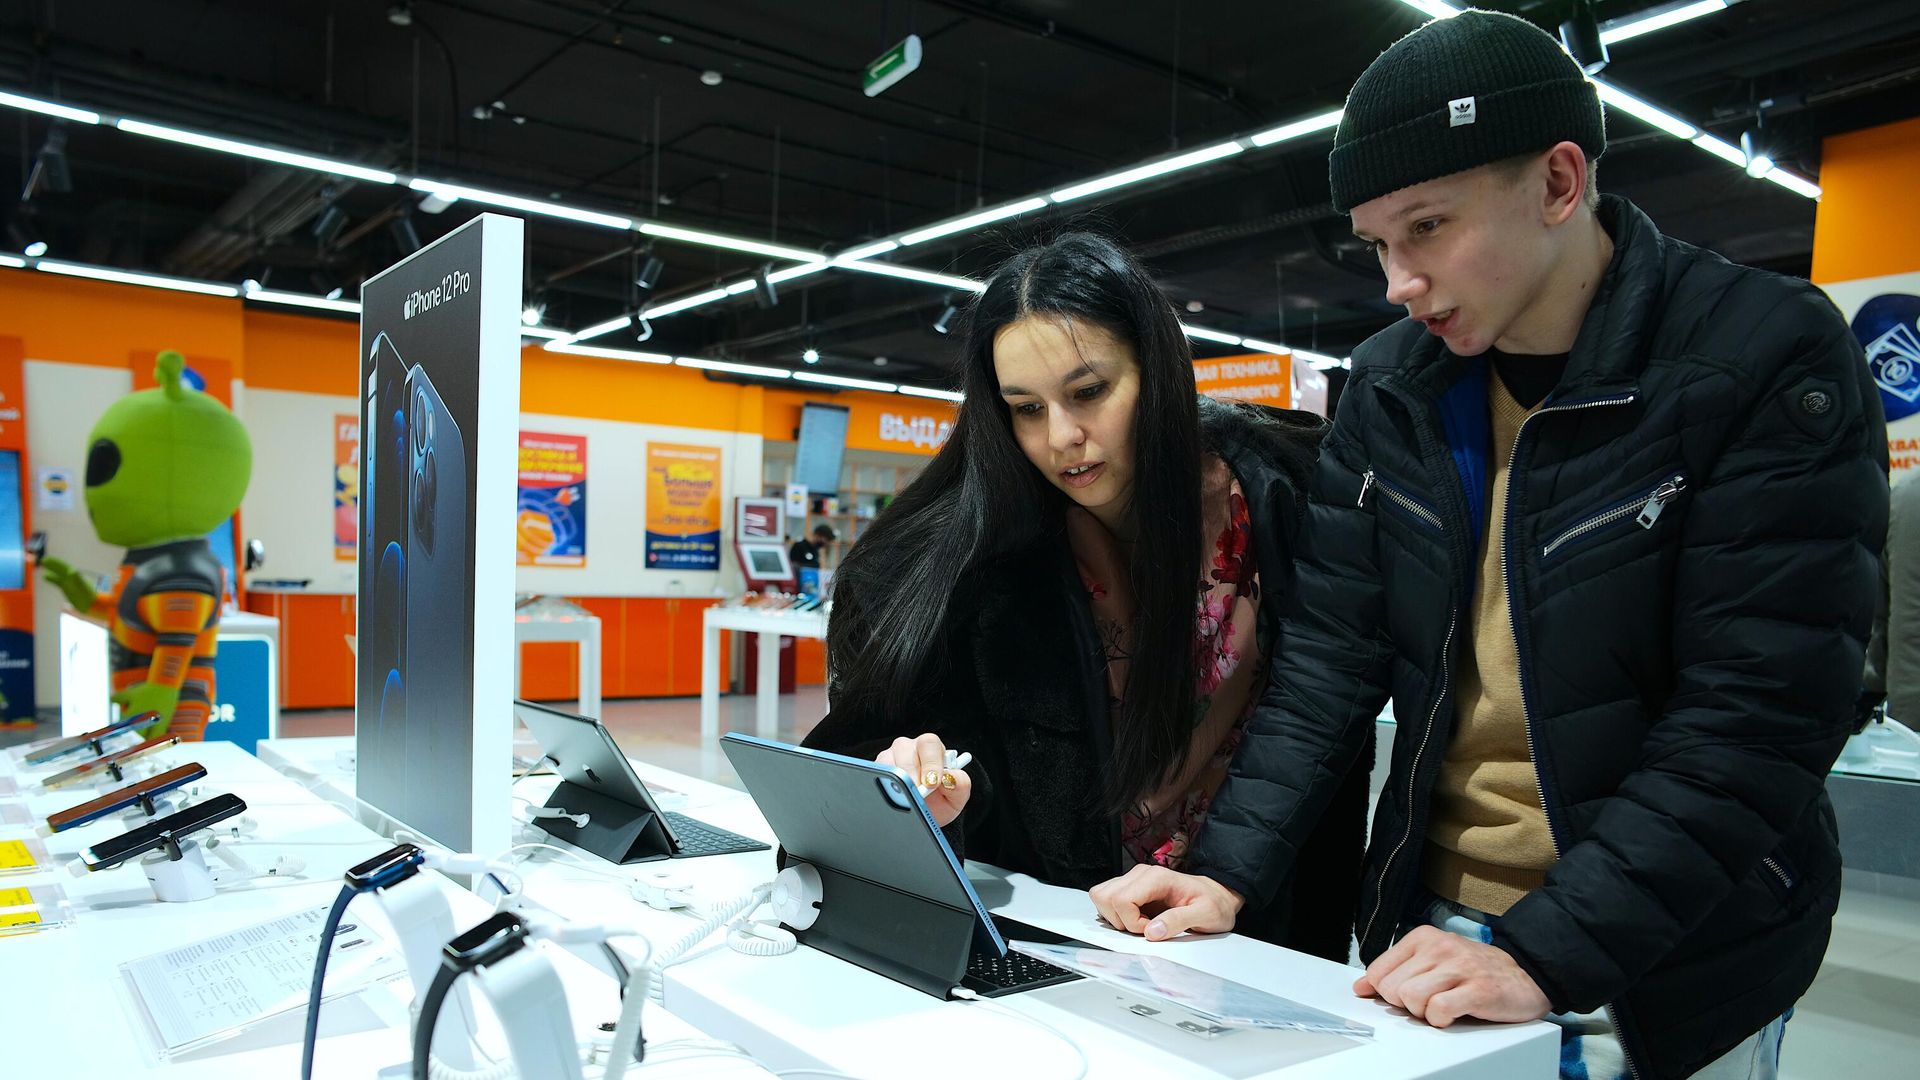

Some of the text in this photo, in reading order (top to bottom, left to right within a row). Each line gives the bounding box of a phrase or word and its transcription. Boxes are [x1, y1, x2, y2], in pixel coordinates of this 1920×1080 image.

[410, 270, 470, 318] iPhone 12 Pro
